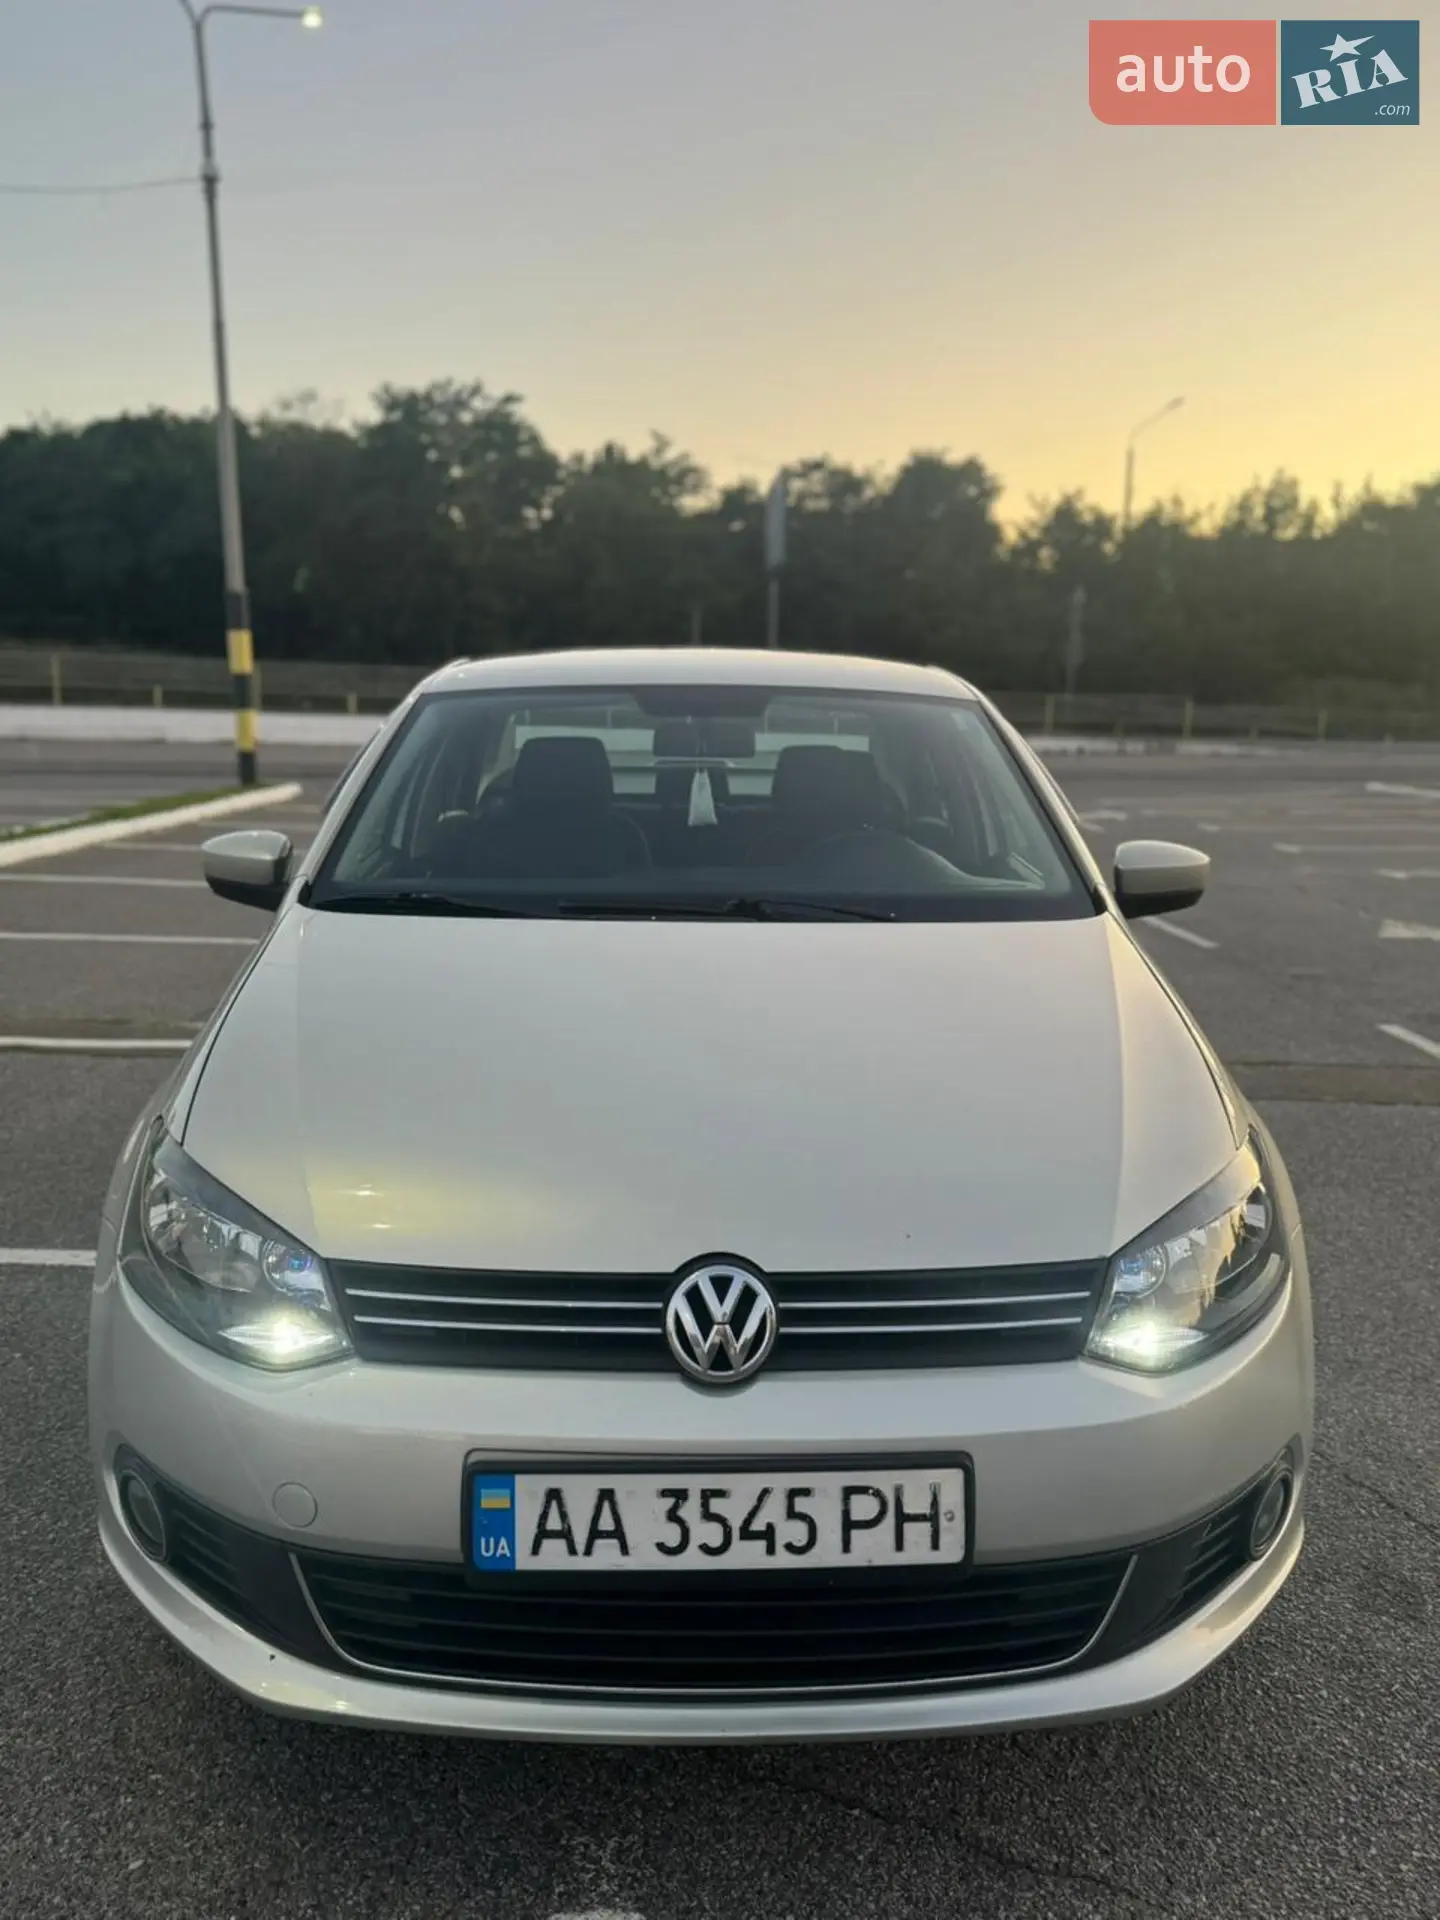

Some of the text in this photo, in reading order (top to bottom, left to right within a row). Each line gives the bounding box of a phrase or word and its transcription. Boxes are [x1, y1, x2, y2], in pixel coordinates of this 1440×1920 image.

[530, 1483, 941, 1557] AA 3545 PH
[480, 1536, 511, 1558] UA
